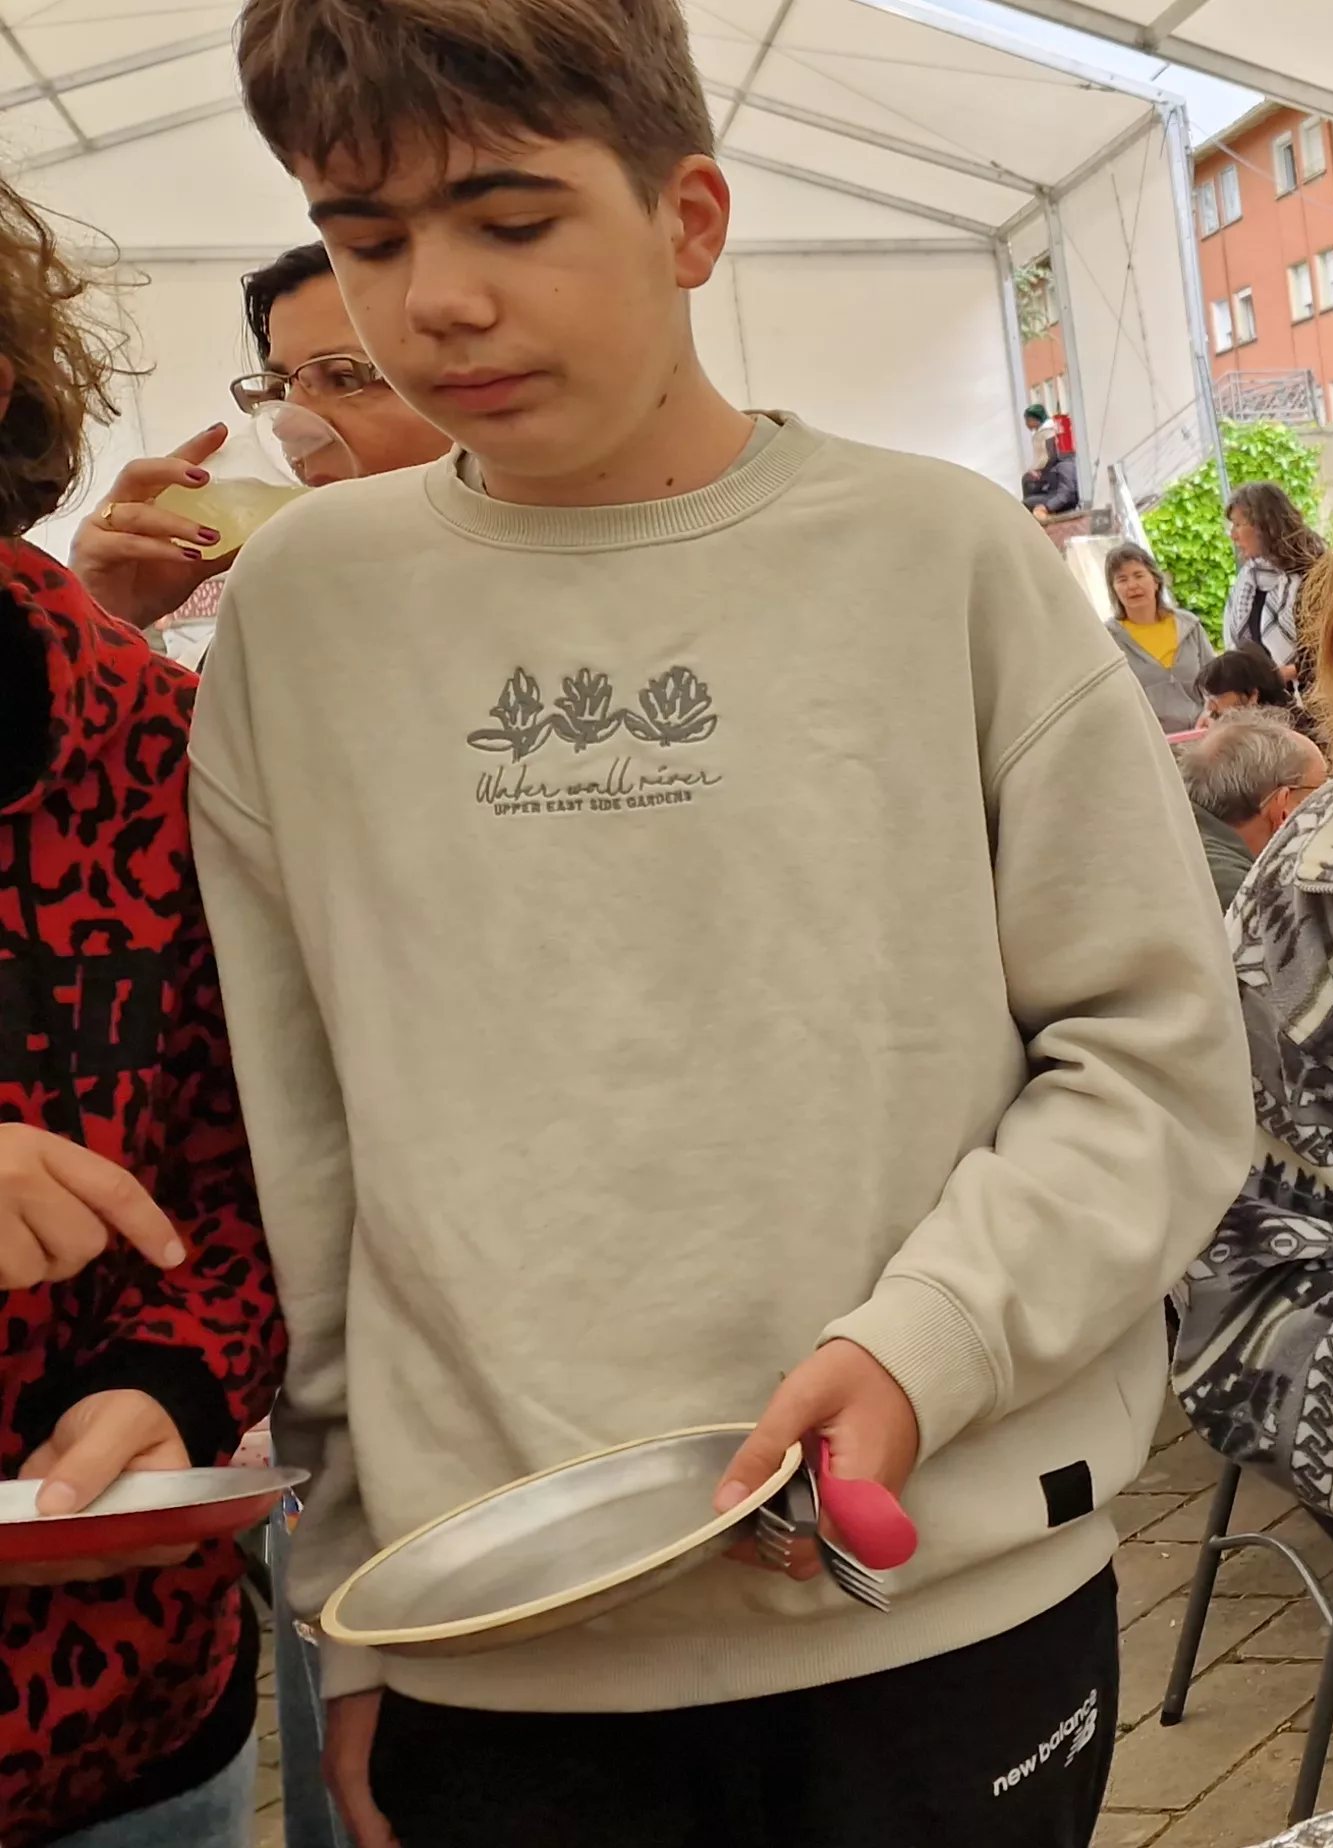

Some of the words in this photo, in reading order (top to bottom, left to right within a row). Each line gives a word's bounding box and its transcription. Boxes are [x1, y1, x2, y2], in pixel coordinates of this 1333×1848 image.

[476, 763, 560, 804] Water
[494, 799, 541, 816] UPPER
[546, 798, 583, 813] EAST
[589, 797, 622, 811] SIDE
[626, 790, 693, 809] GARDENS
[993, 1753, 1038, 1797] new
[1038, 1687, 1098, 1764] balance
